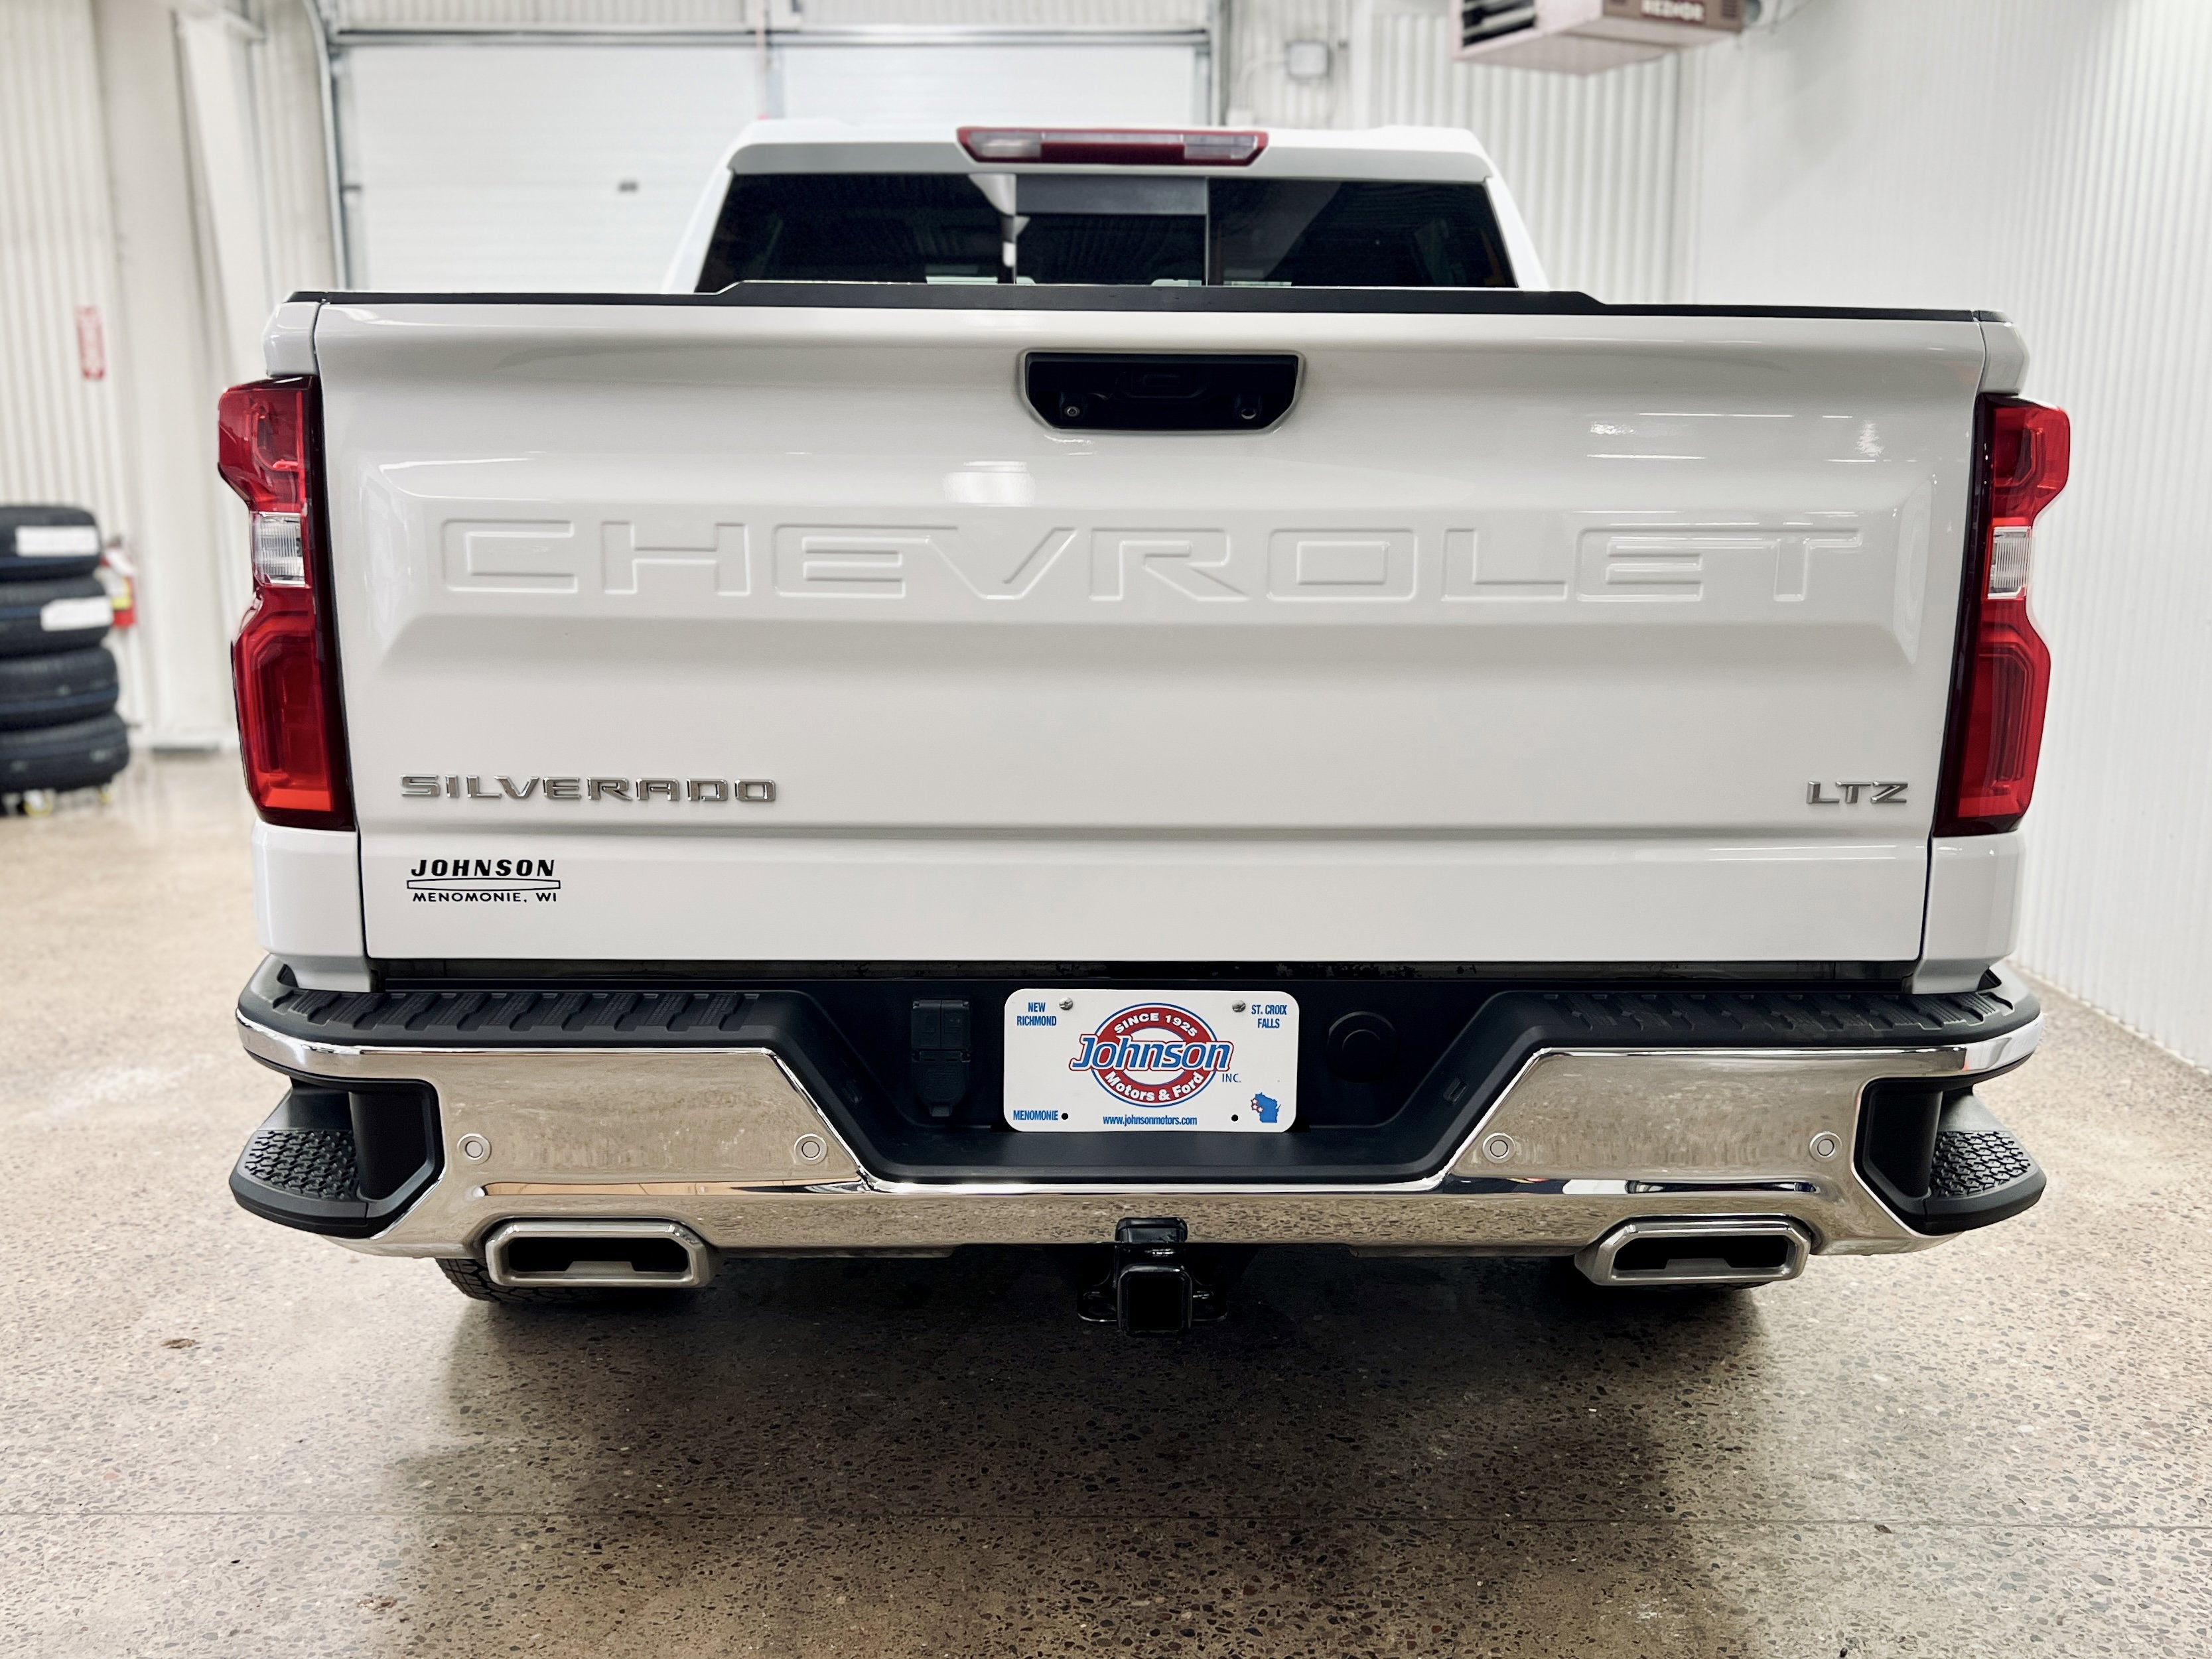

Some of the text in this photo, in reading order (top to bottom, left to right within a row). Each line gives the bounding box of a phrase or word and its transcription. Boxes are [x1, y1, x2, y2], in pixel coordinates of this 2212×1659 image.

[442, 519, 1863, 603] CHEVROLET
[399, 774, 777, 802] SILVERADO
[1806, 781, 1908, 804] LTZ
[411, 859, 555, 877] JOHNSON
[412, 892, 557, 903] MENOMONIE, WI
[1028, 1002, 1046, 1013] NEW
[1251, 1004, 1288, 1016] ST. CROIX
[1016, 1015, 1057, 1026] RICHMOND
[1114, 1012, 1198, 1037] SINCE 1925
[1257, 1018, 1280, 1029] FALLS
[1070, 1035, 1233, 1069] Johnson
[1221, 1073, 1242, 1083] INC.
[1104, 1071, 1204, 1102] Motors & Ford
[1012, 1110, 1059, 1121] MENOMONIE
[1102, 1114, 1198, 1126] www.johnsonmotors.com
